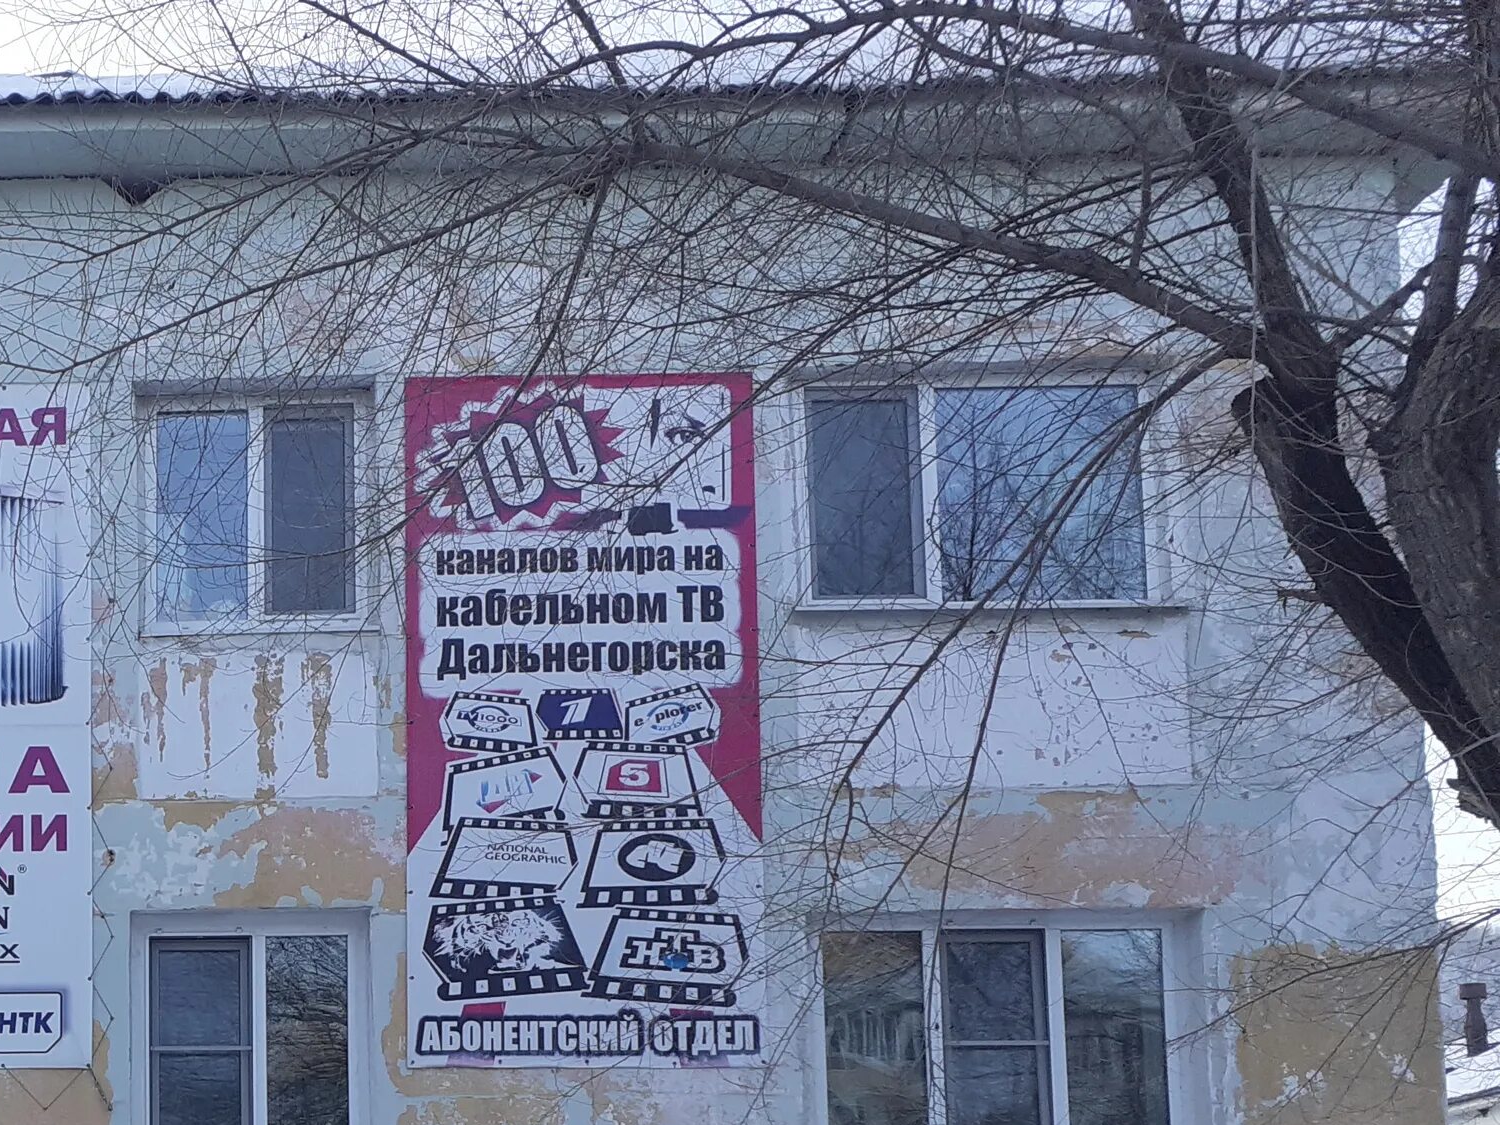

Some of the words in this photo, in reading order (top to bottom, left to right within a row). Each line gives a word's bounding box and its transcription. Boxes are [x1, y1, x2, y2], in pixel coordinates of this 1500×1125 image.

[440, 403, 602, 522] 100
[436, 546, 578, 576] каналов
[586, 544, 675, 575] мира
[683, 543, 724, 572] на
[436, 583, 668, 627] кабельном
[676, 584, 725, 623] ТВ
[436, 638, 726, 681] Дальнегорска
[457, 709, 523, 728] TV1000
[633, 700, 705, 728] eplorer
[618, 762, 650, 787] 5
[485, 852, 568, 866] GEOGRAPHIC
[486, 843, 549, 857] NATIONAL
[420, 1013, 641, 1053] АБОНЕНТСКИЙ
[653, 1018, 756, 1055] ОТДЕЛ
